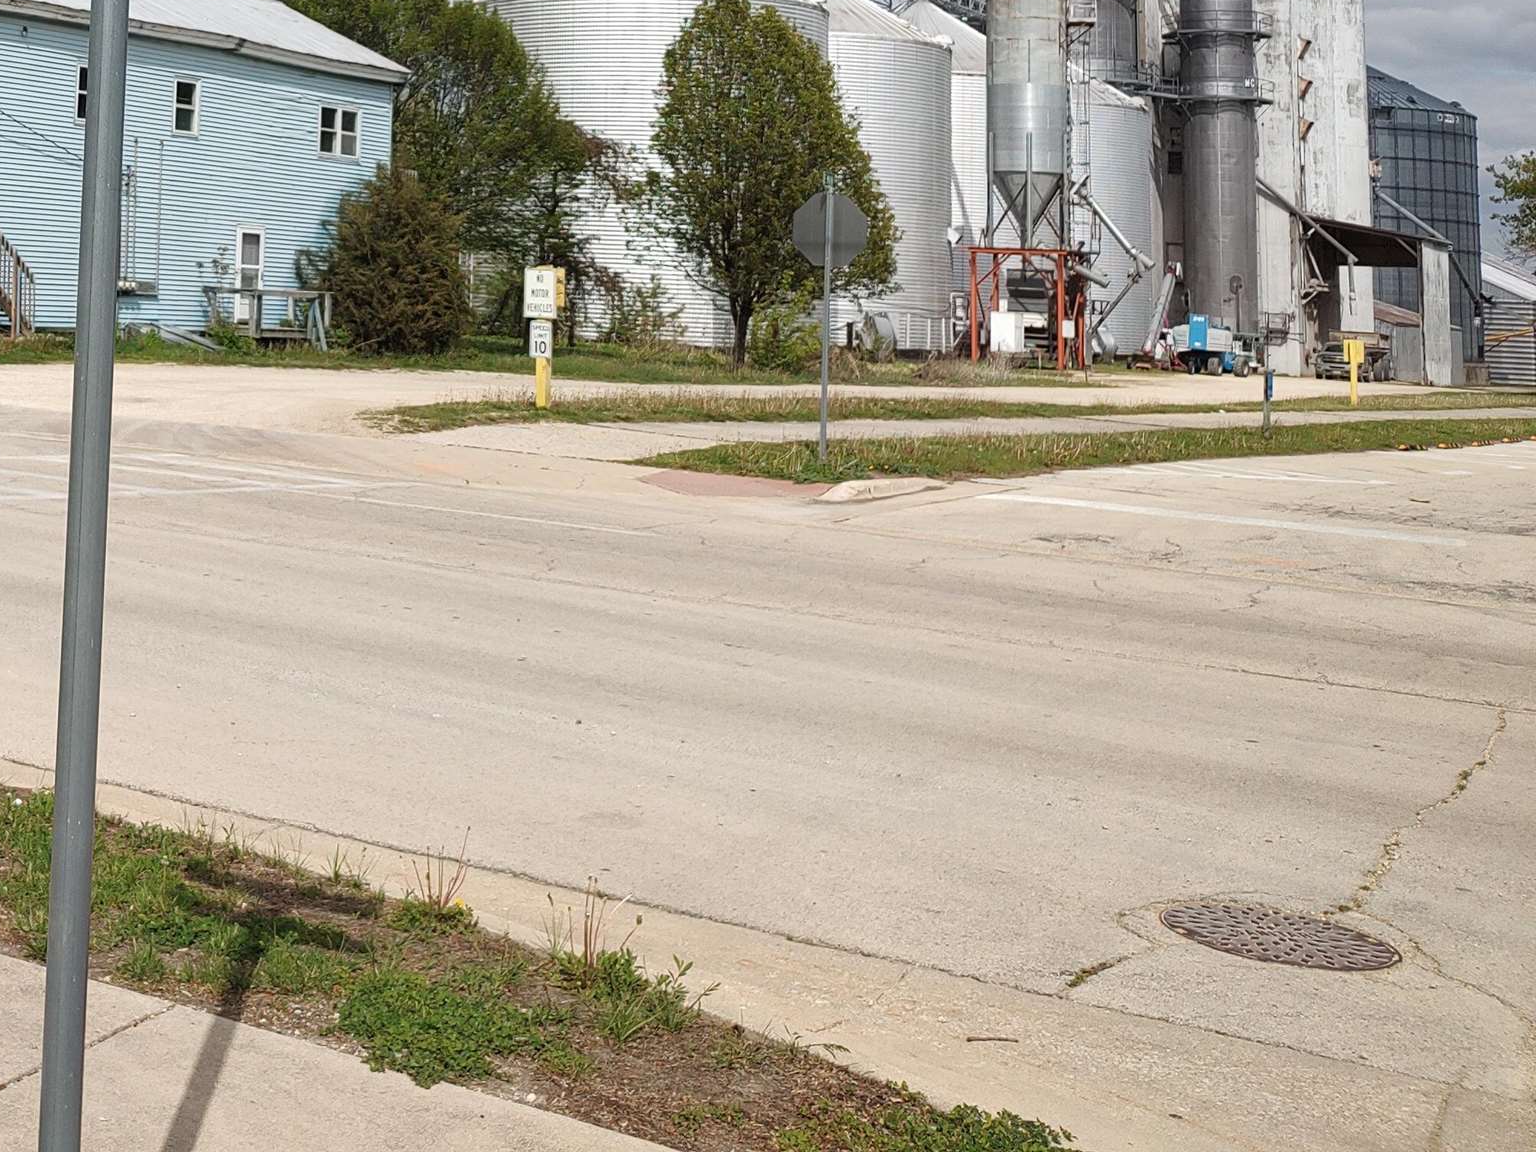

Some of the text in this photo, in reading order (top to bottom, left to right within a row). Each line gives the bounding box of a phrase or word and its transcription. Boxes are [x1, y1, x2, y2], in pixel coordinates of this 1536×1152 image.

[531, 288, 549, 298] MOTOR
[527, 303, 553, 313] VEHICLES
[534, 340, 547, 354] 10
